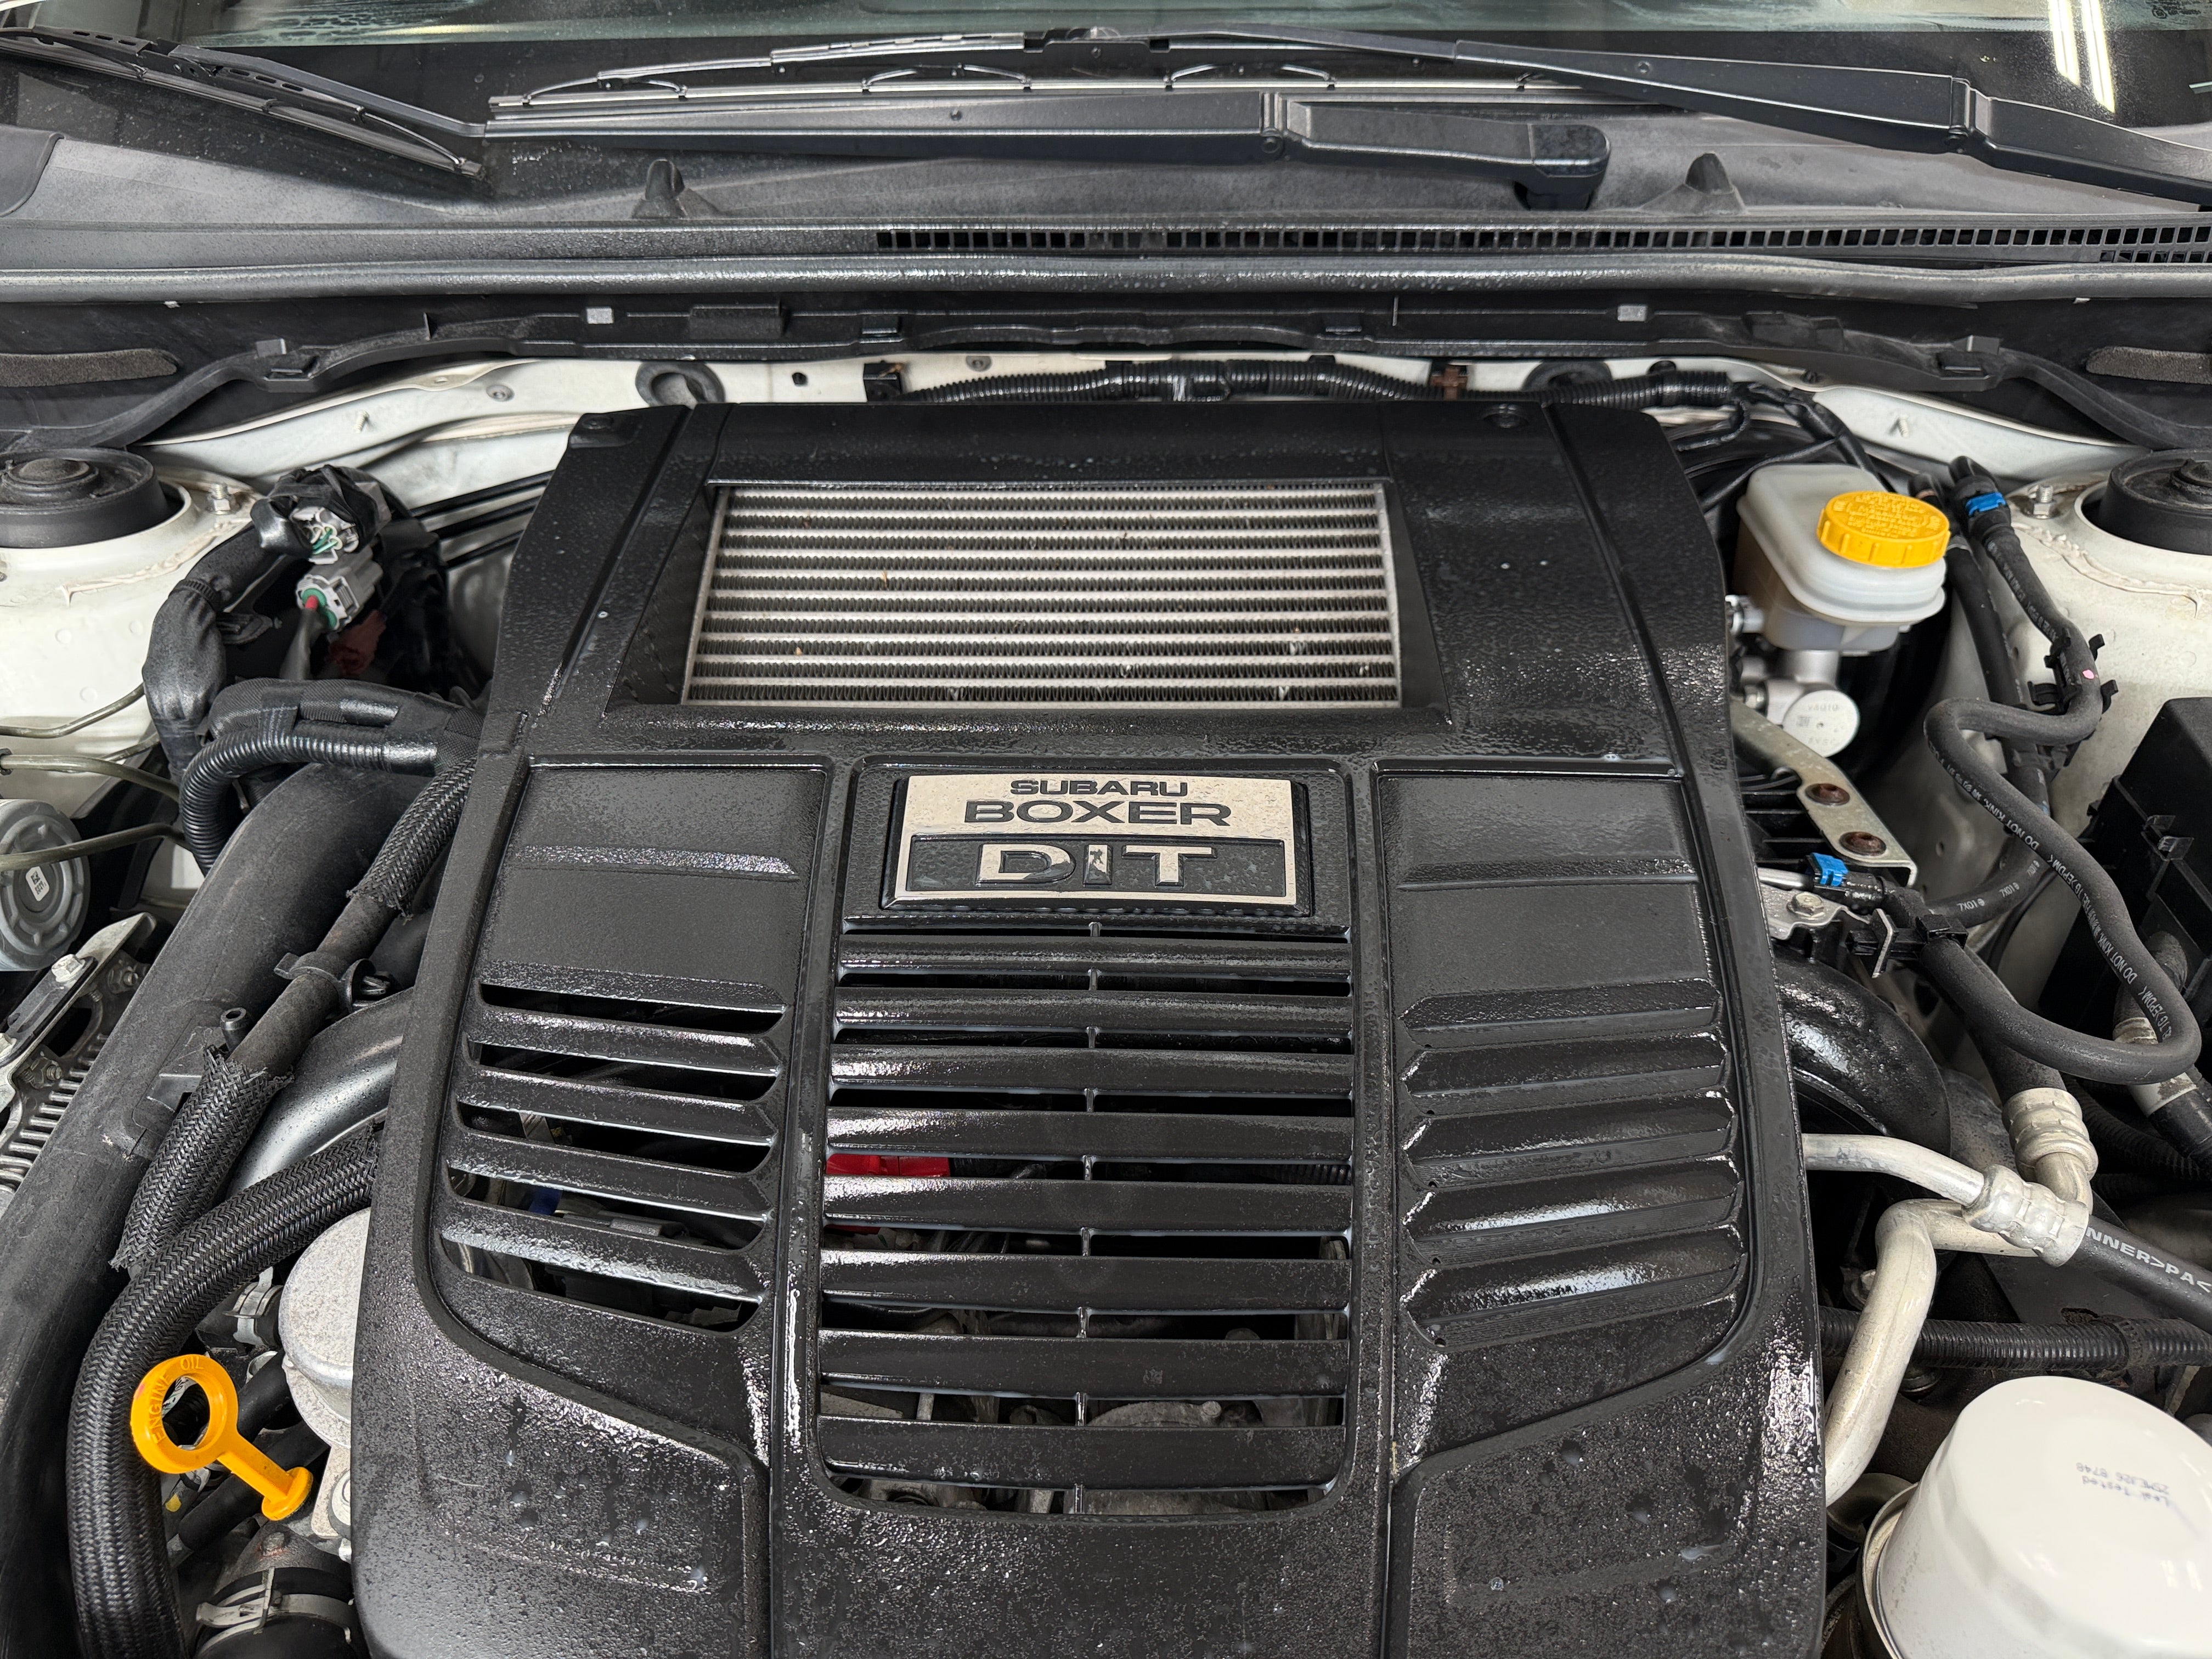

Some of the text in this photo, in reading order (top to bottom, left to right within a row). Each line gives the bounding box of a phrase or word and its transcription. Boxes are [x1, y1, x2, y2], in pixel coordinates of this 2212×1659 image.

[1010, 780, 1188, 797] SUBARU
[964, 800, 1232, 826] BOXER
[2006, 819, 2025, 839] NOT
[2024, 835, 2040, 850] DO
[976, 843, 1217, 887] DIT
[2110, 951, 2128, 973] NOT
[2122, 967, 2138, 985] DO
[149, 1356, 204, 1444] ENGINE OIL
[2081, 1475, 2131, 1497] Tested
